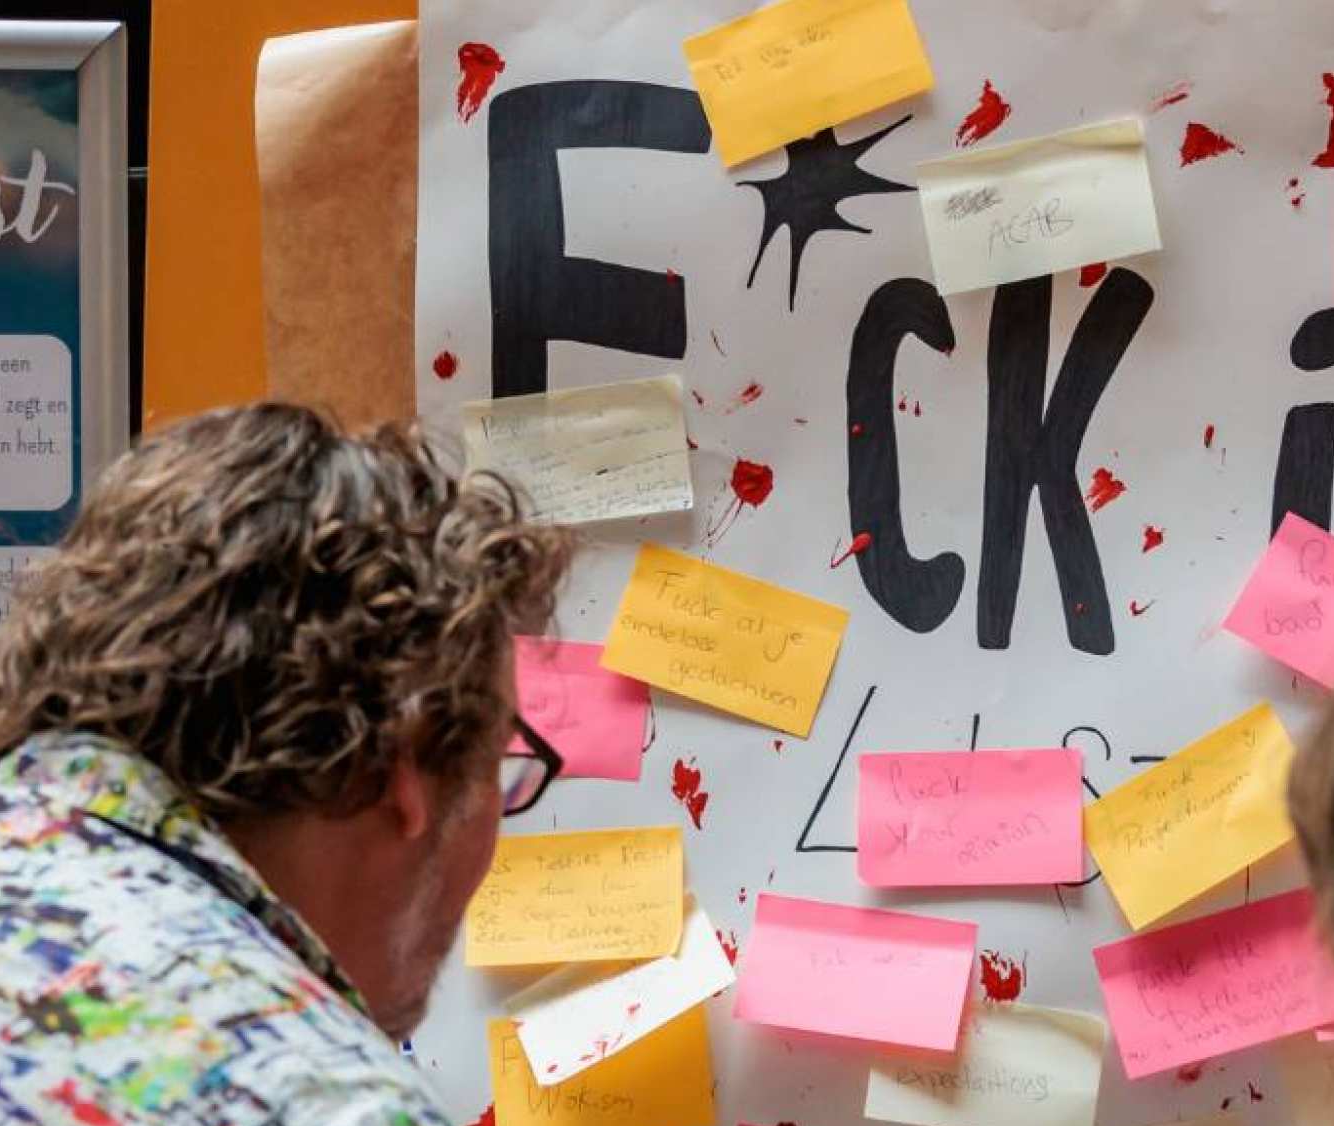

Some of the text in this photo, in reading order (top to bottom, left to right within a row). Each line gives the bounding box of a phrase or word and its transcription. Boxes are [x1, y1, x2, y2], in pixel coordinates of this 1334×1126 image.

[0, 354, 31, 373] een
[5, 396, 43, 420] zegt
[47, 398, 69, 413] en
[16, 426, 62, 455] hebt.
